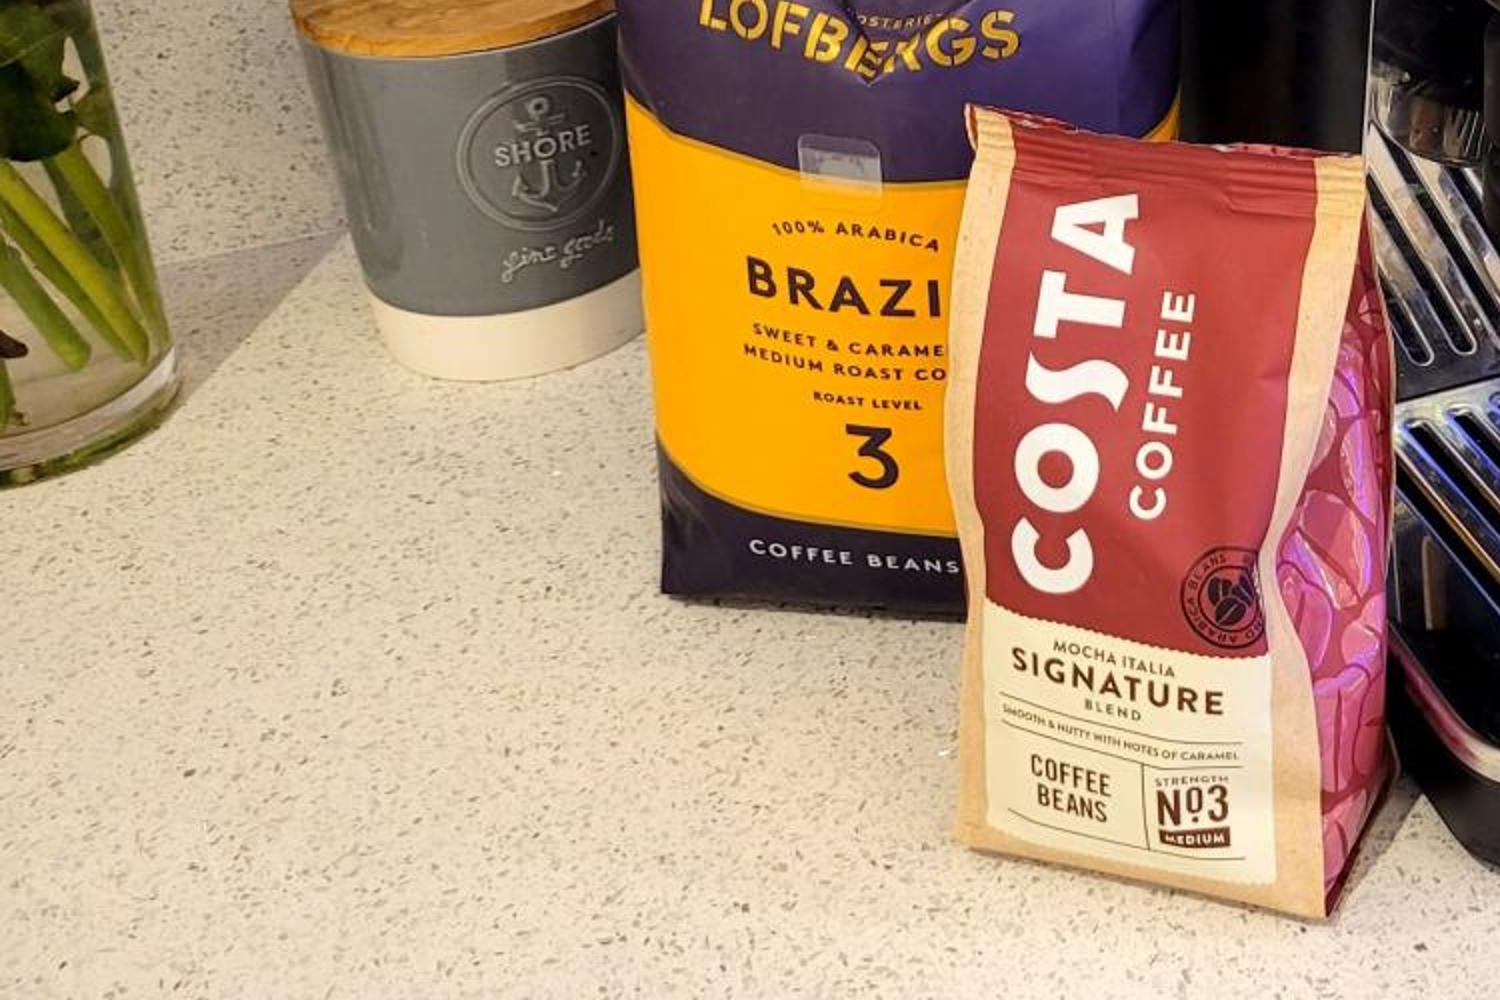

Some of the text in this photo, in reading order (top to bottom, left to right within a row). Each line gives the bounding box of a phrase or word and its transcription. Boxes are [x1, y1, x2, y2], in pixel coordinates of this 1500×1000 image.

[494, 124, 592, 168] SHORE
[771, 219, 940, 253] 100% ARABICA
[746, 255, 942, 318] BRAZI
[752, 322, 945, 358] SWEET & CARAME
[743, 343, 823, 373] MEDIUM
[833, 363, 905, 382] ROAST
[813, 391, 924, 411] ROAST LEVEL
[1010, 193, 1140, 595] COSTA
[1128, 290, 1197, 521] COFFEE
[845, 423, 900, 490] 3
[749, 538, 961, 575] COFFEE BEANS
[1052, 639, 1176, 678] MOCHA ITALIA
[1011, 647, 1225, 716] SIGNATURE
[1084, 698, 1142, 722] BLEND
[1002, 703, 1046, 726] SMOOTH
[1056, 723, 1091, 742] NUTTY
[1092, 732, 1121, 748] WITH
[1123, 740, 1160, 758] NOTES
[1160, 748, 1178, 761] OF
[1179, 750, 1240, 762] CARAMEL
[1030, 752, 1113, 799] COFFEE
[1153, 775, 1230, 788] STRENGTH
[1036, 782, 1108, 824] BEANS
[1164, 832, 1226, 846] MEDIUM
